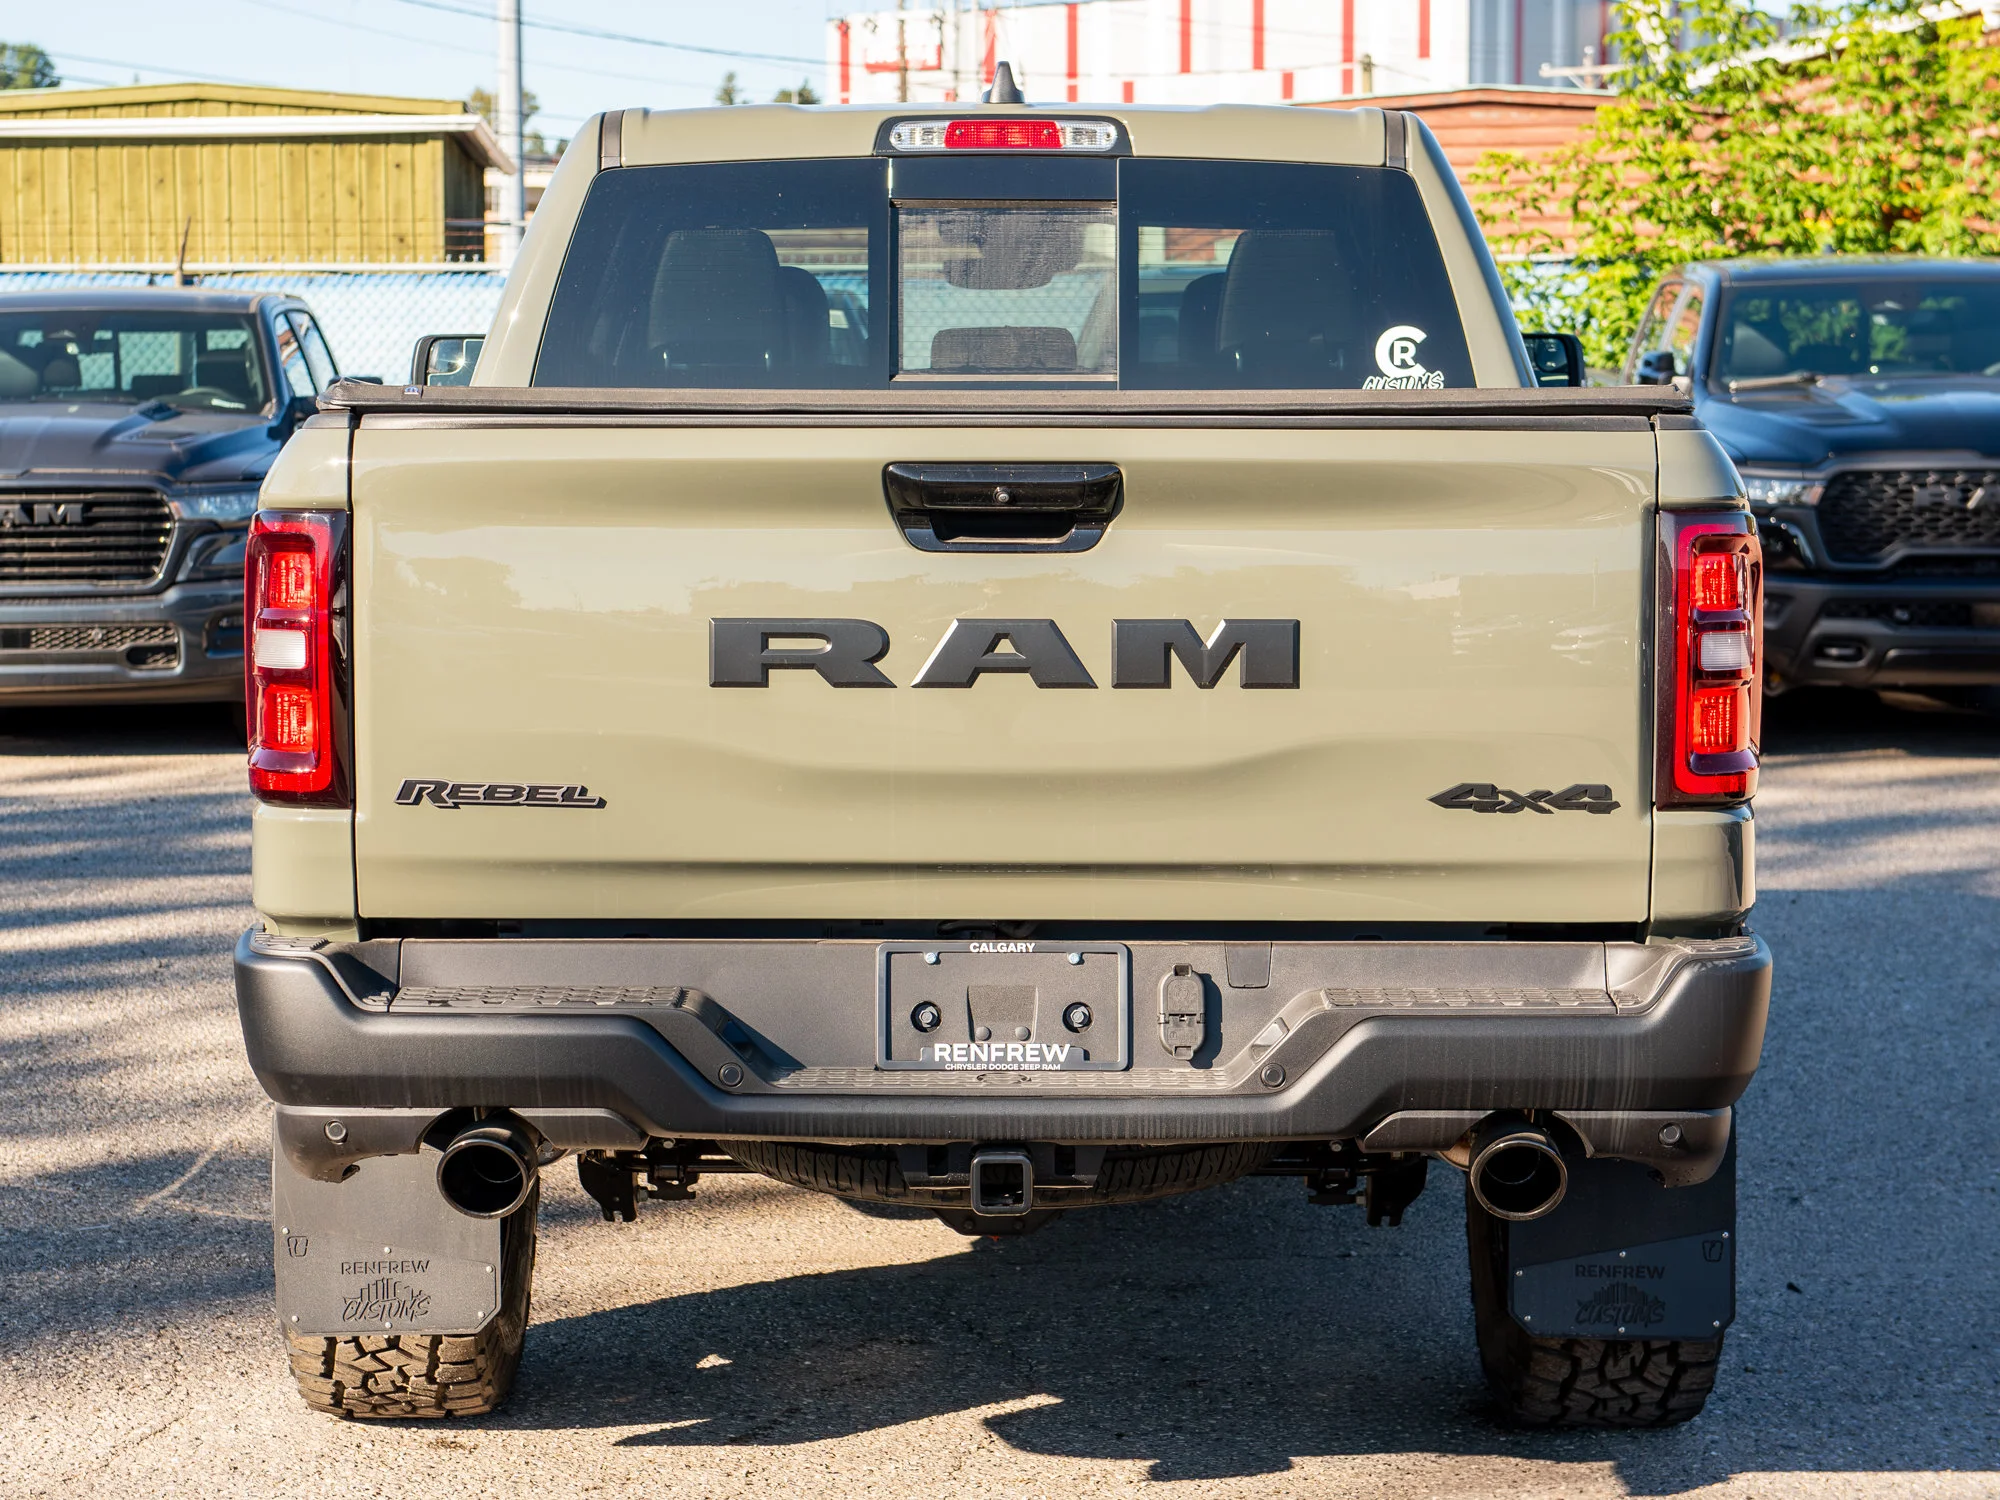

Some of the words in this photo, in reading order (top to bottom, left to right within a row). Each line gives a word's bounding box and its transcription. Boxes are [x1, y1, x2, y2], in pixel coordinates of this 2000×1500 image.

[0, 503, 83, 524] AM
[709, 617, 1301, 689] RAM
[394, 778, 607, 809] REBEL
[969, 942, 1036, 953] CALGARY
[934, 1043, 1071, 1062] RENFREW
[945, 1063, 988, 1071] CHRYSLER
[989, 1063, 1018, 1071] DODGE
[1020, 1063, 1040, 1071] JEEP
[1041, 1063, 1061, 1071] RAM
[341, 1260, 430, 1275] RENFREW
[1575, 1264, 1665, 1279] RENFREW
[342, 1294, 432, 1322] CUSTOMS
